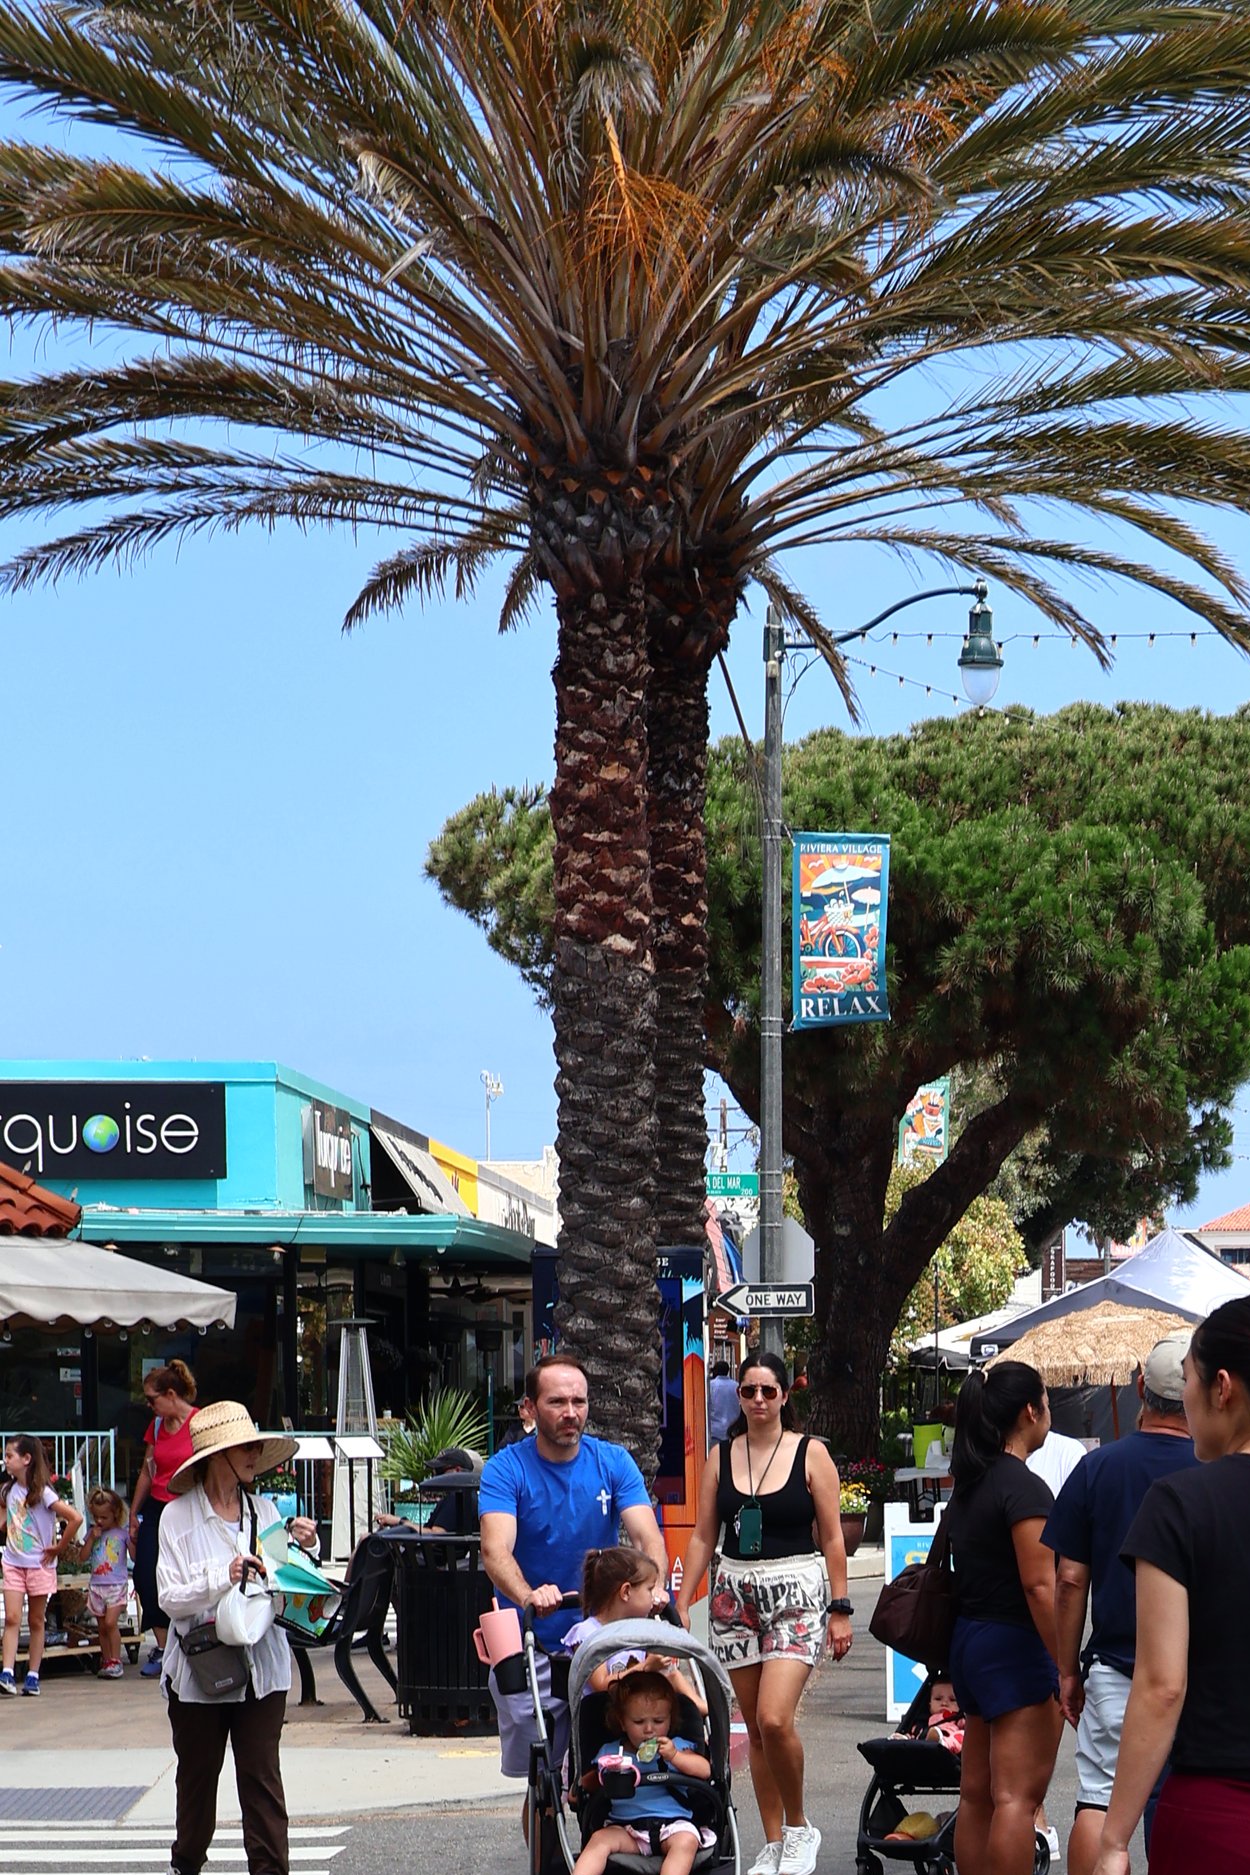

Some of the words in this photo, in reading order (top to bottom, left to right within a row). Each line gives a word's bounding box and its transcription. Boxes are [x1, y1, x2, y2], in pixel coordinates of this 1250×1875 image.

[800, 843, 839, 853] RIVIERA
[841, 843, 882, 854] VILLAGE
[801, 996, 882, 1018] RELAX
[712, 1176, 725, 1190] DEL
[726, 1176, 741, 1190] MAR
[741, 1188, 753, 1196] 200
[745, 1293, 771, 1306] ONE
[776, 1293, 802, 1306] WAY
